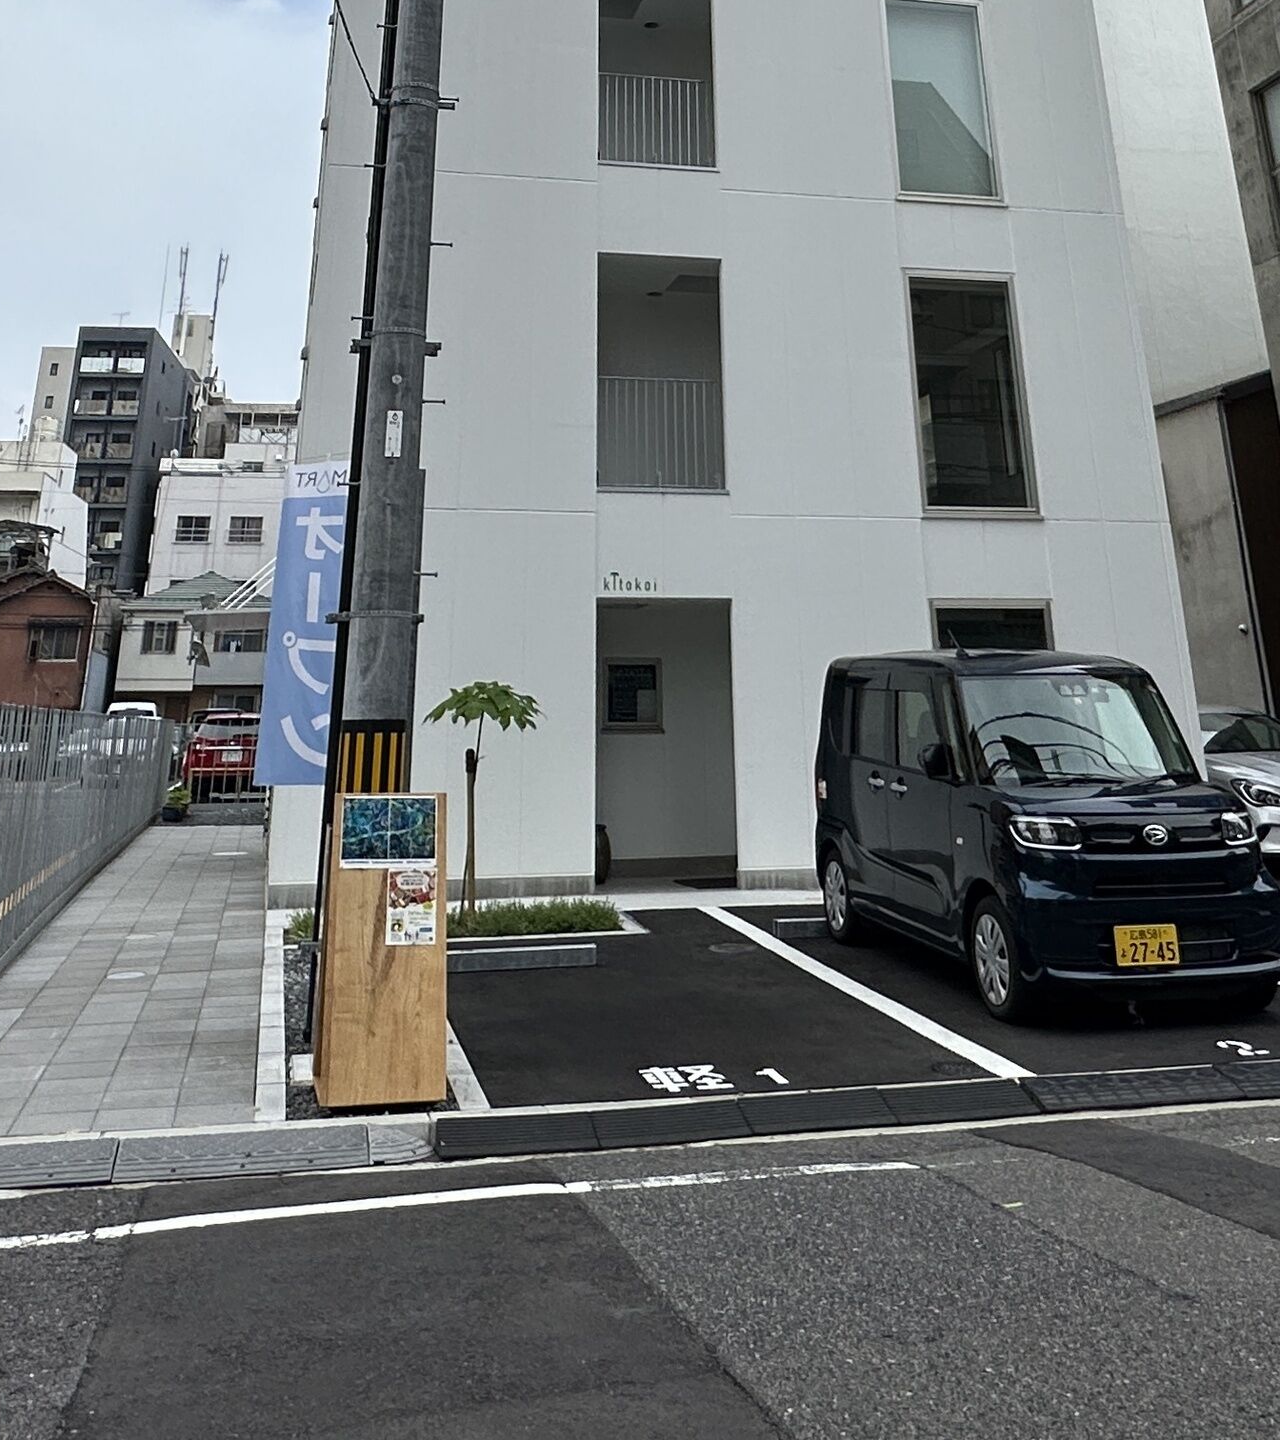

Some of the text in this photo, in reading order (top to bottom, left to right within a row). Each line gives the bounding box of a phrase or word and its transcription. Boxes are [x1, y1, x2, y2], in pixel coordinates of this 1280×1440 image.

[1129, 941, 1176, 963] 27-45
[1216, 1039, 1270, 1056] 2
[638, 1064, 790, 1093] 軽 1
